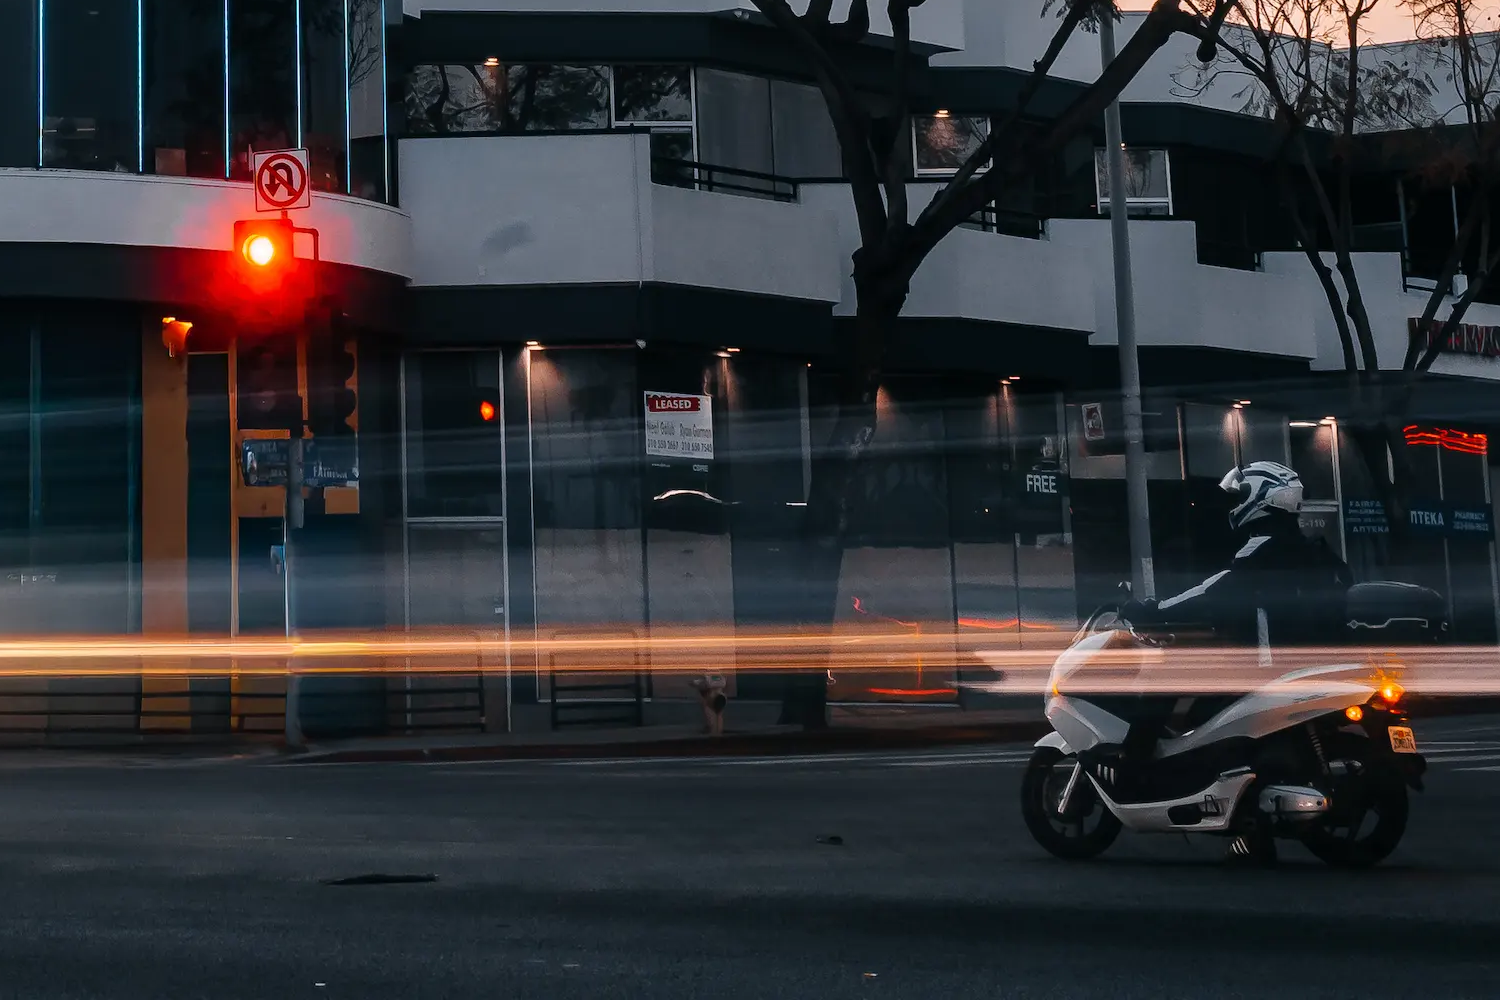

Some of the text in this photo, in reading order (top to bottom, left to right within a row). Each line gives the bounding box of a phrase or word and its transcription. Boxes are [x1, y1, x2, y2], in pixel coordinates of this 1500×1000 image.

[655, 399, 692, 410] LEASED
[1026, 473, 1057, 493] FREE
[1410, 510, 1445, 526] ПТЕКА
